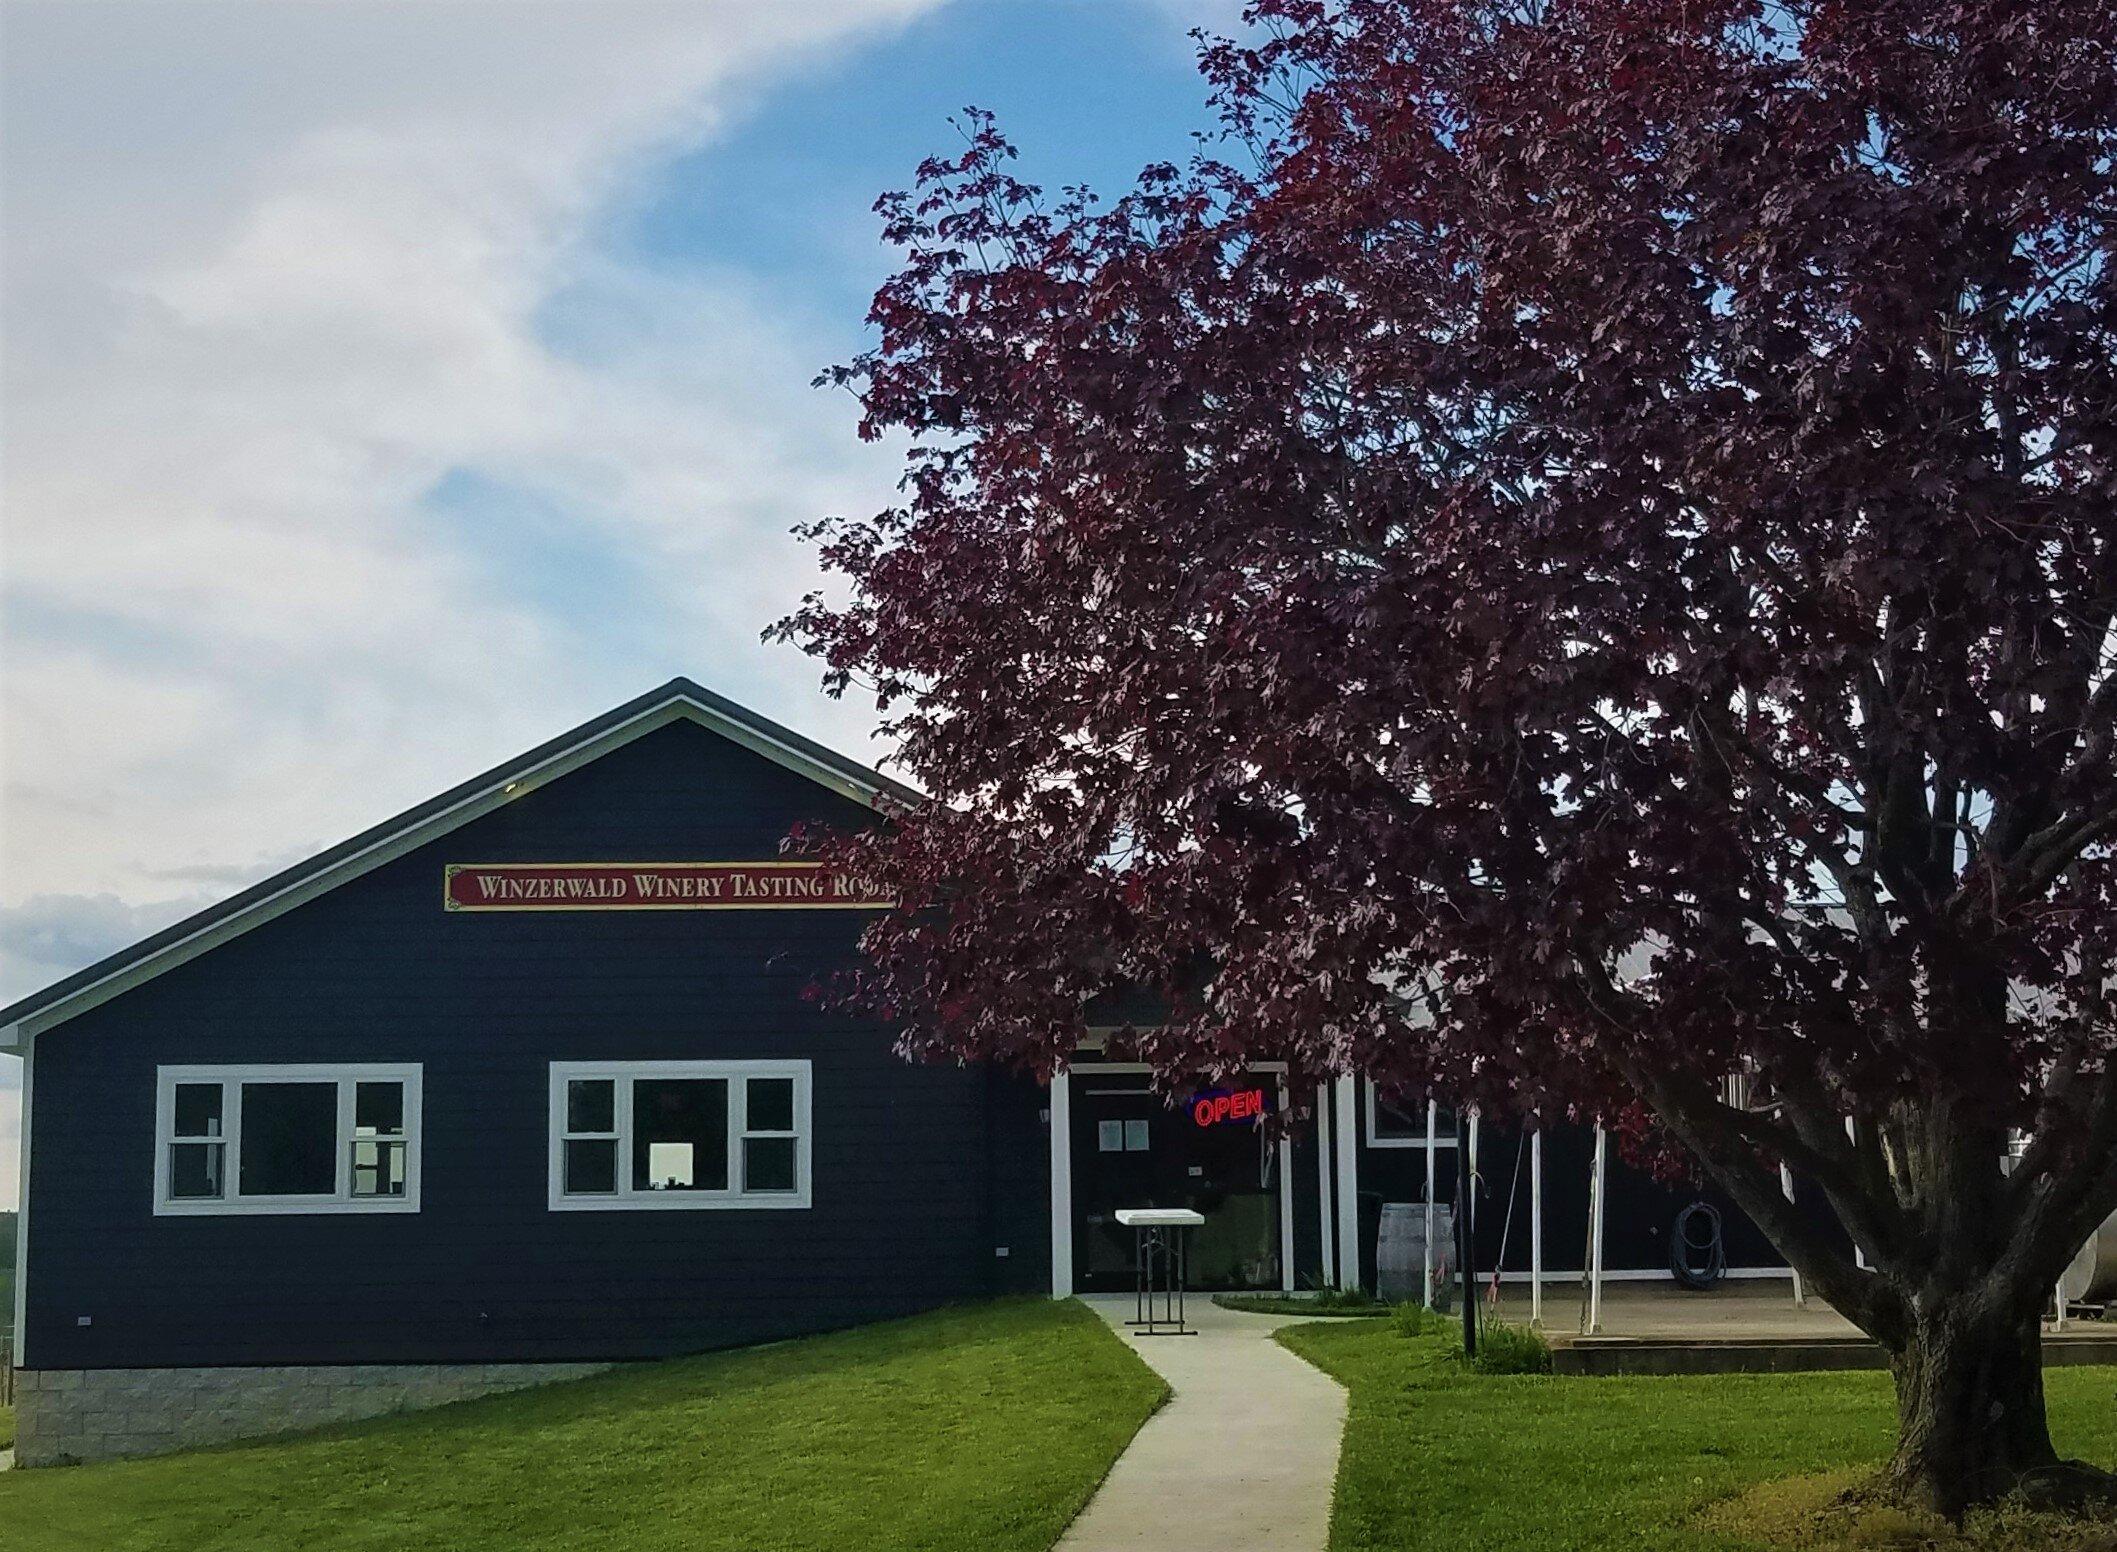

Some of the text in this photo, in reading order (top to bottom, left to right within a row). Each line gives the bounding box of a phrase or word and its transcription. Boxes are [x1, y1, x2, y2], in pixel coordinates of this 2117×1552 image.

[478, 874, 627, 899] WINZERWALD
[633, 873, 725, 898] WINERY
[730, 872, 825, 898] TASTING
[1195, 1089, 1262, 1126] OPEN
